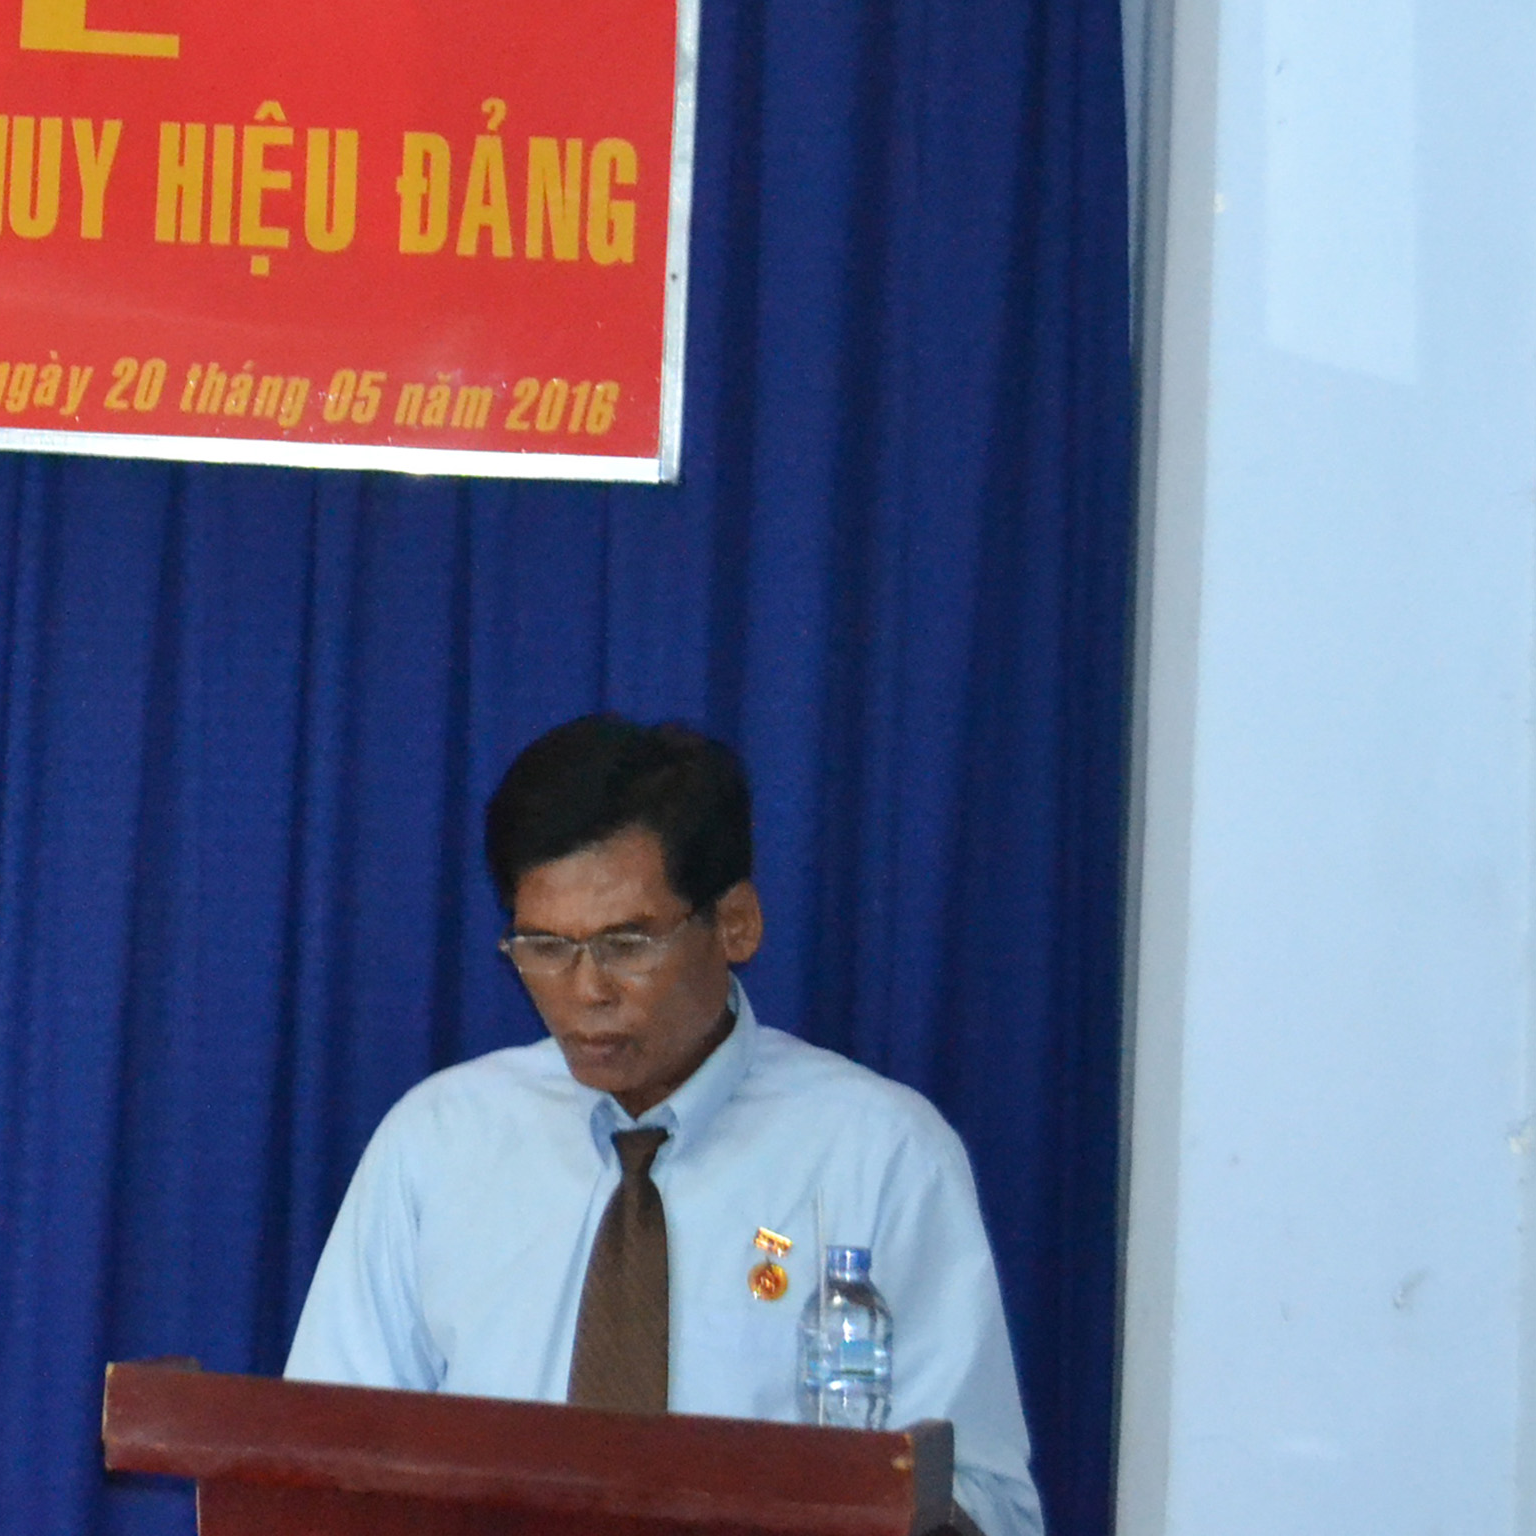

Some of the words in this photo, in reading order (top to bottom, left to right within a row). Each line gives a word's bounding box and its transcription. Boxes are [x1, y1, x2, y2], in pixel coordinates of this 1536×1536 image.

[155, 100, 360, 277] HIỆU
[395, 98, 640, 267] ĐẢNG
[103, 357, 169, 413] 20
[179, 360, 311, 429] tháng
[323, 368, 387, 425] 05
[393, 371, 494, 430] năm
[505, 376, 621, 436] 2016
